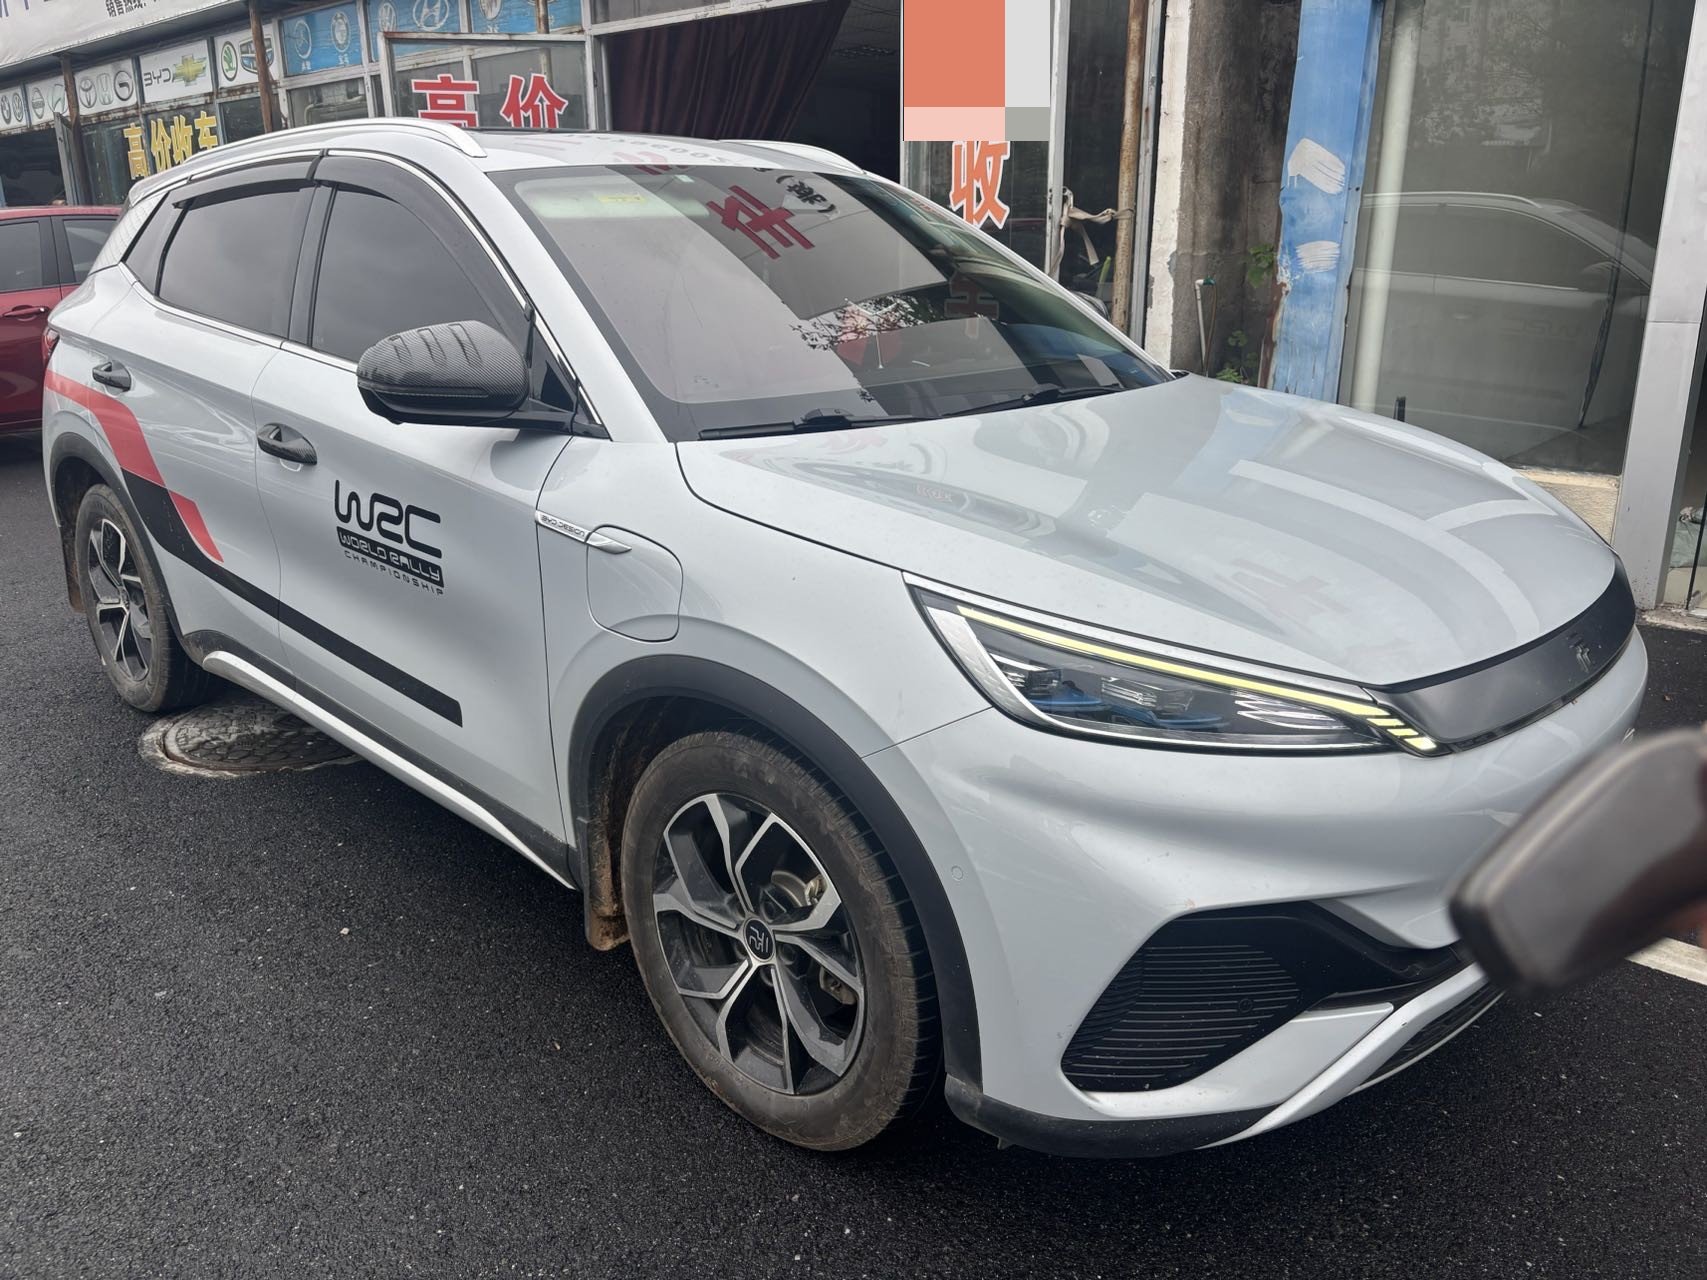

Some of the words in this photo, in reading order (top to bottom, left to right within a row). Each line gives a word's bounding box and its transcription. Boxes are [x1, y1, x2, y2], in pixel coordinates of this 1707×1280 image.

[144, 68, 172, 87] BYD
[411, 73, 569, 129] 高价
[123, 111, 218, 180] 高价收车
[950, 140, 1011, 229] 收
[334, 480, 442, 559] WRC
[541, 515, 557, 526] BYD
[558, 522, 586, 537] DESIGN
[339, 531, 387, 560] WORLD
[389, 547, 441, 581] RALLY
[344, 550, 444, 595] CHAMPIONSHIP
